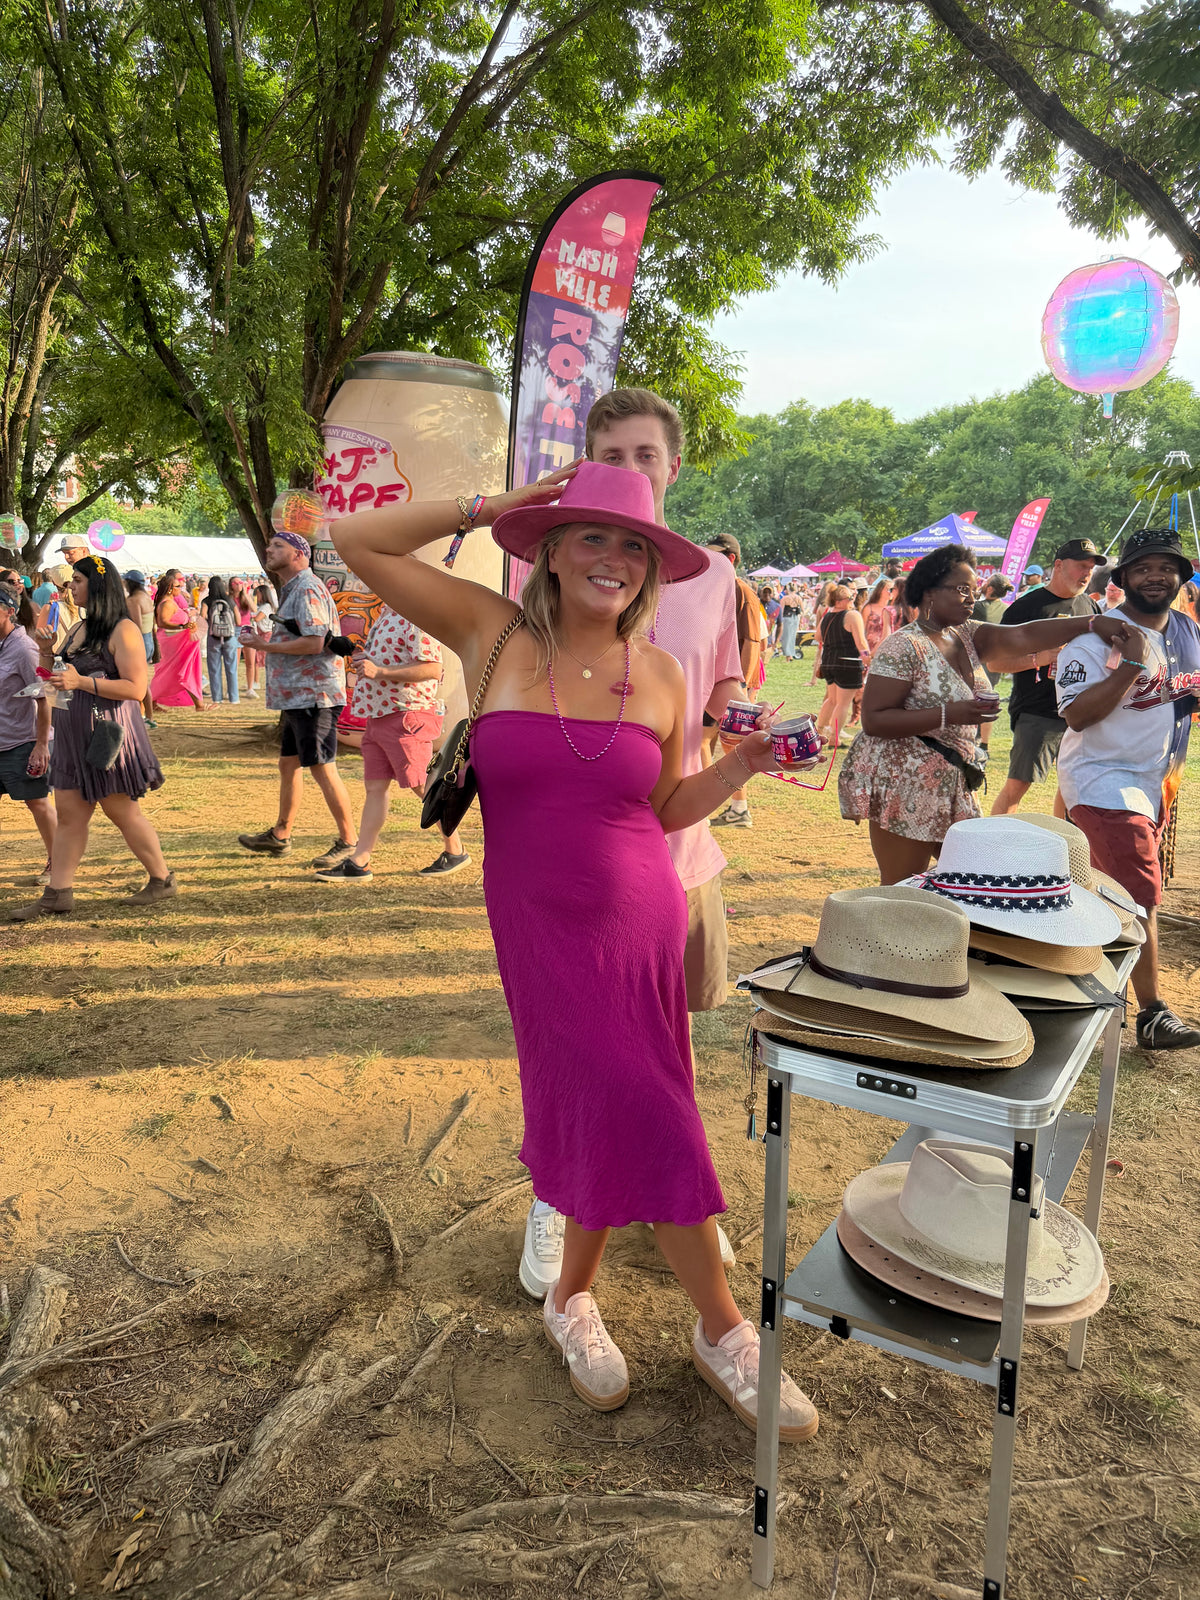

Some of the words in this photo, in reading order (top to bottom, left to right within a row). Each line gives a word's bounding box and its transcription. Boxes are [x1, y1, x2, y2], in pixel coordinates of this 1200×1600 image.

[558, 239, 619, 279] NASH
[554, 267, 611, 309] VILLE
[341, 430, 387, 451] PRESENTS
